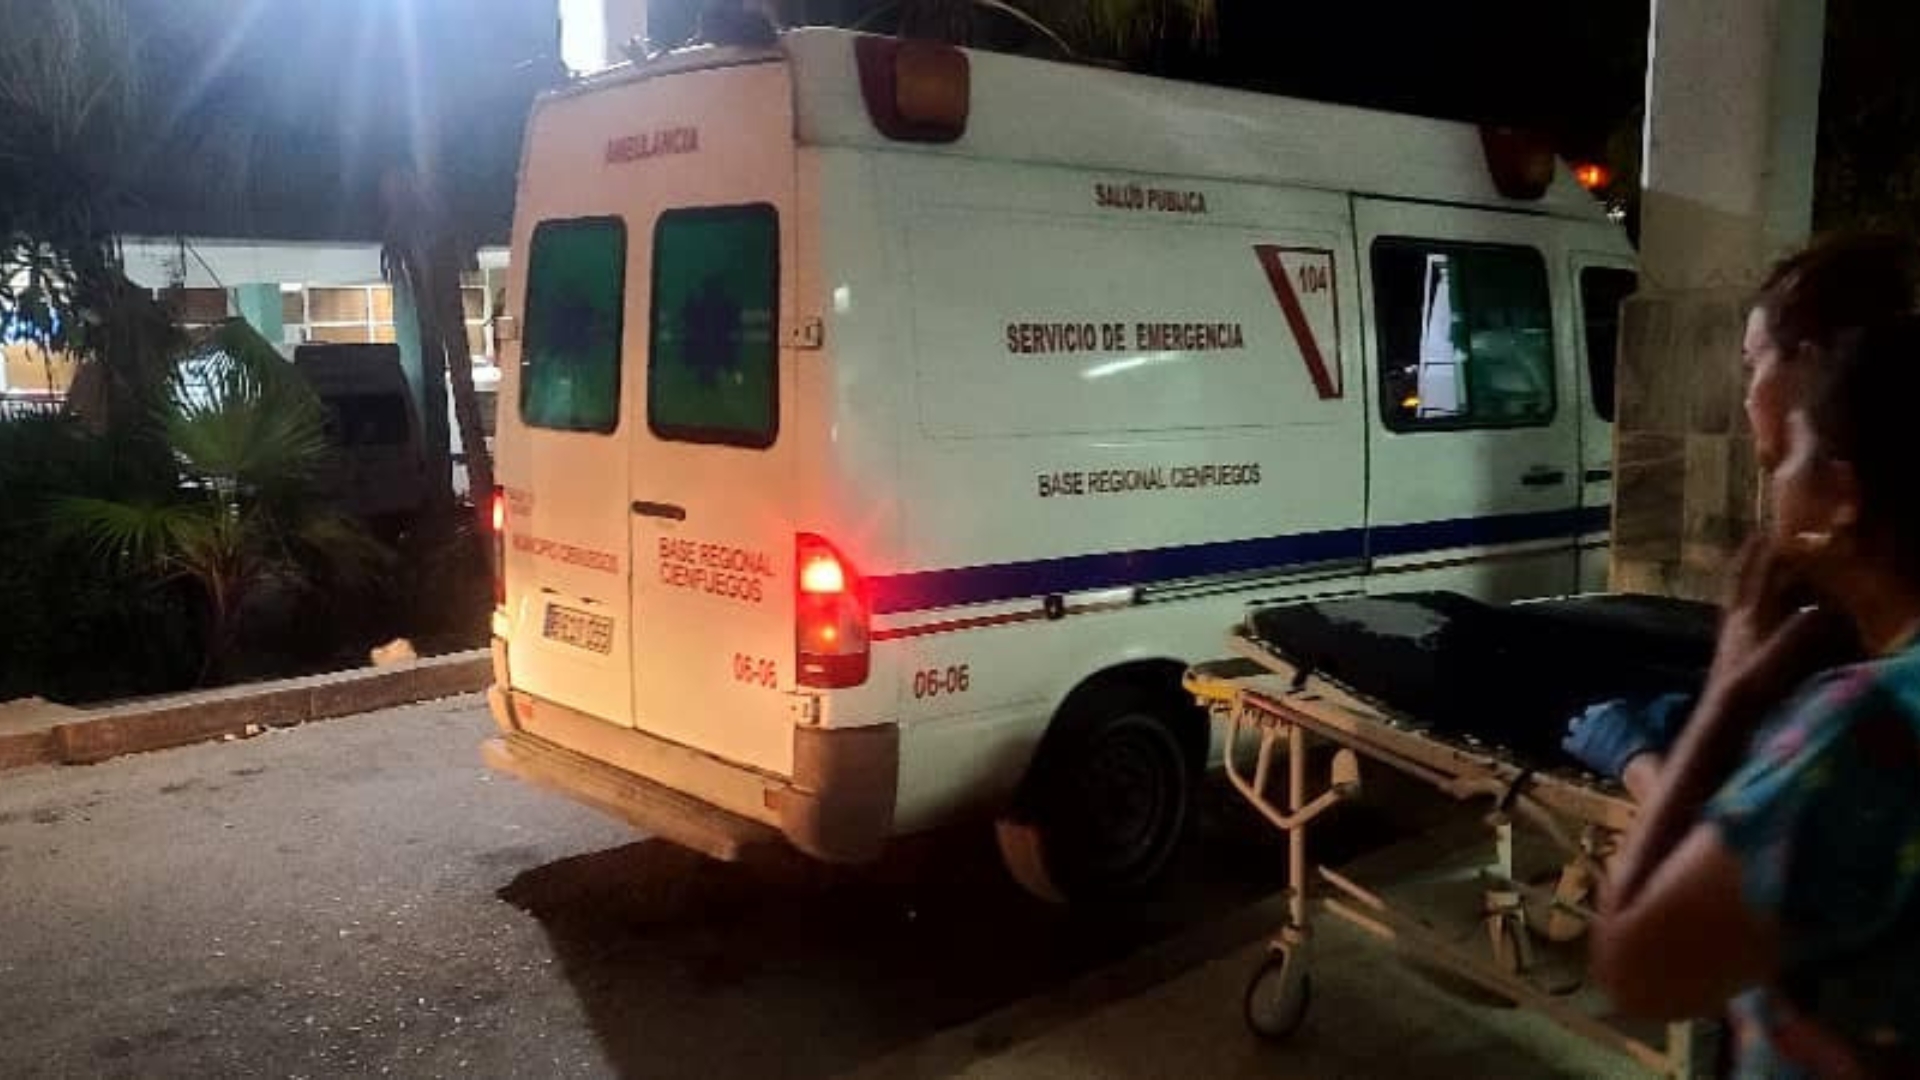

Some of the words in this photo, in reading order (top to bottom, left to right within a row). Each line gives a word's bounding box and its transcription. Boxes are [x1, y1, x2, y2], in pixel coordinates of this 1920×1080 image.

[1299, 266, 1328, 294] 104
[1007, 323, 1097, 353] SERVICIO
[1102, 323, 1126, 351] DE
[1137, 323, 1243, 350] EMERGENCIA
[1039, 474, 1084, 497] BASE
[1088, 467, 1166, 492] REGIONAL
[1170, 463, 1261, 488] CIENFUEGOS
[659, 537, 696, 563] BASE
[699, 543, 776, 576] REGIONAL
[660, 562, 763, 603] CIENFUEGOS
[913, 664, 970, 699] 06-06
